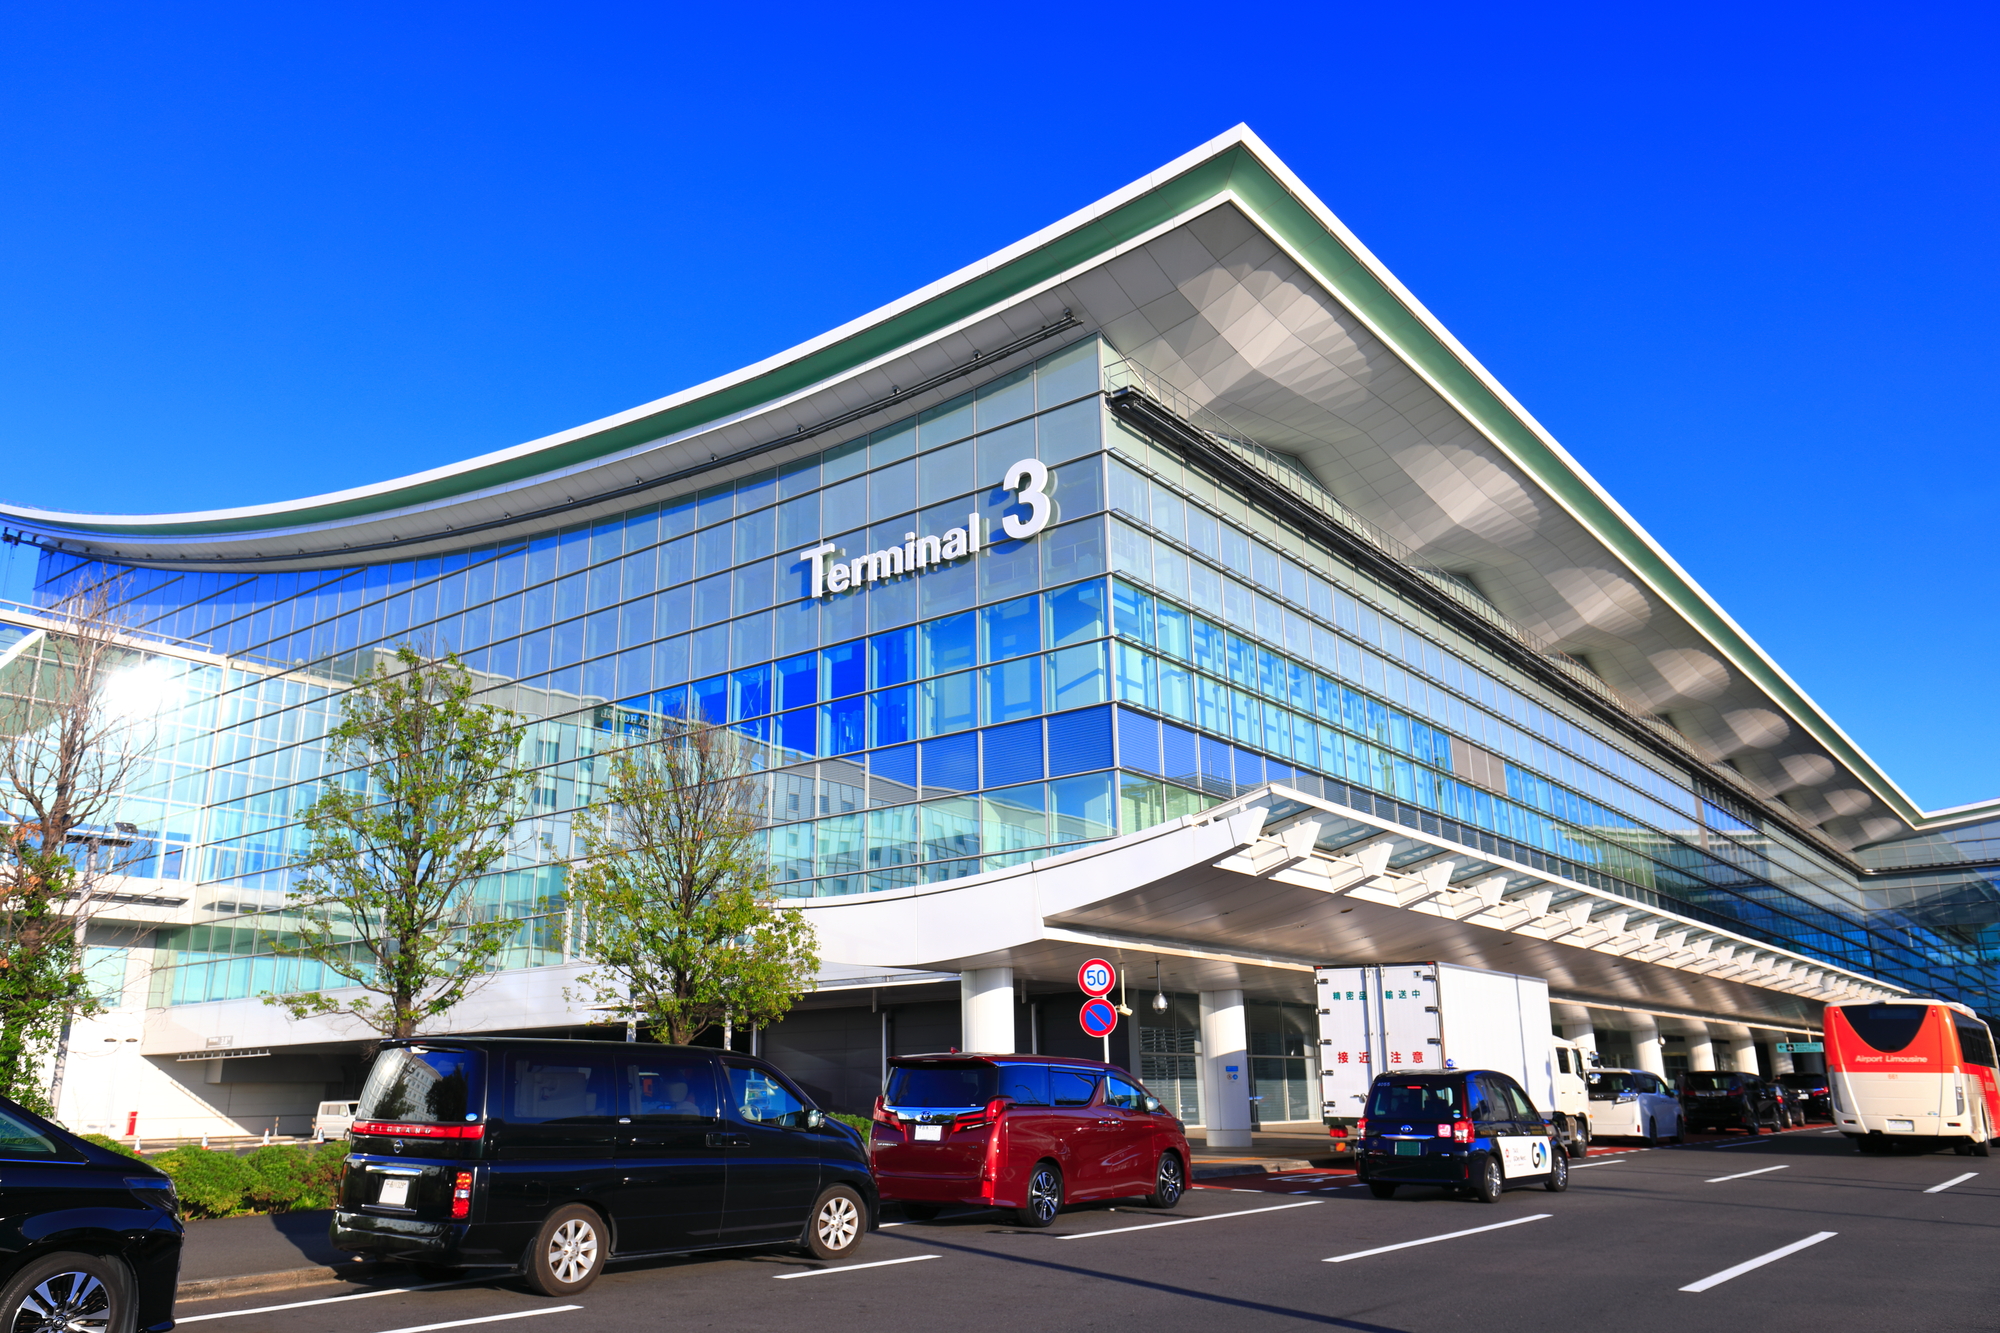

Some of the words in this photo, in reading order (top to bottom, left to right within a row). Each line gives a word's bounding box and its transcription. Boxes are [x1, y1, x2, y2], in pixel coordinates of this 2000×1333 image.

[800, 512, 980, 598] Terminal
[1002, 458, 1051, 539] 3
[1086, 969, 1107, 986] 50
[1337, 1051, 1371, 1064] 接近
[1390, 1051, 1424, 1064] 注意
[1855, 1055, 1883, 1063] Airport
[1532, 1142, 1547, 1169] GO
